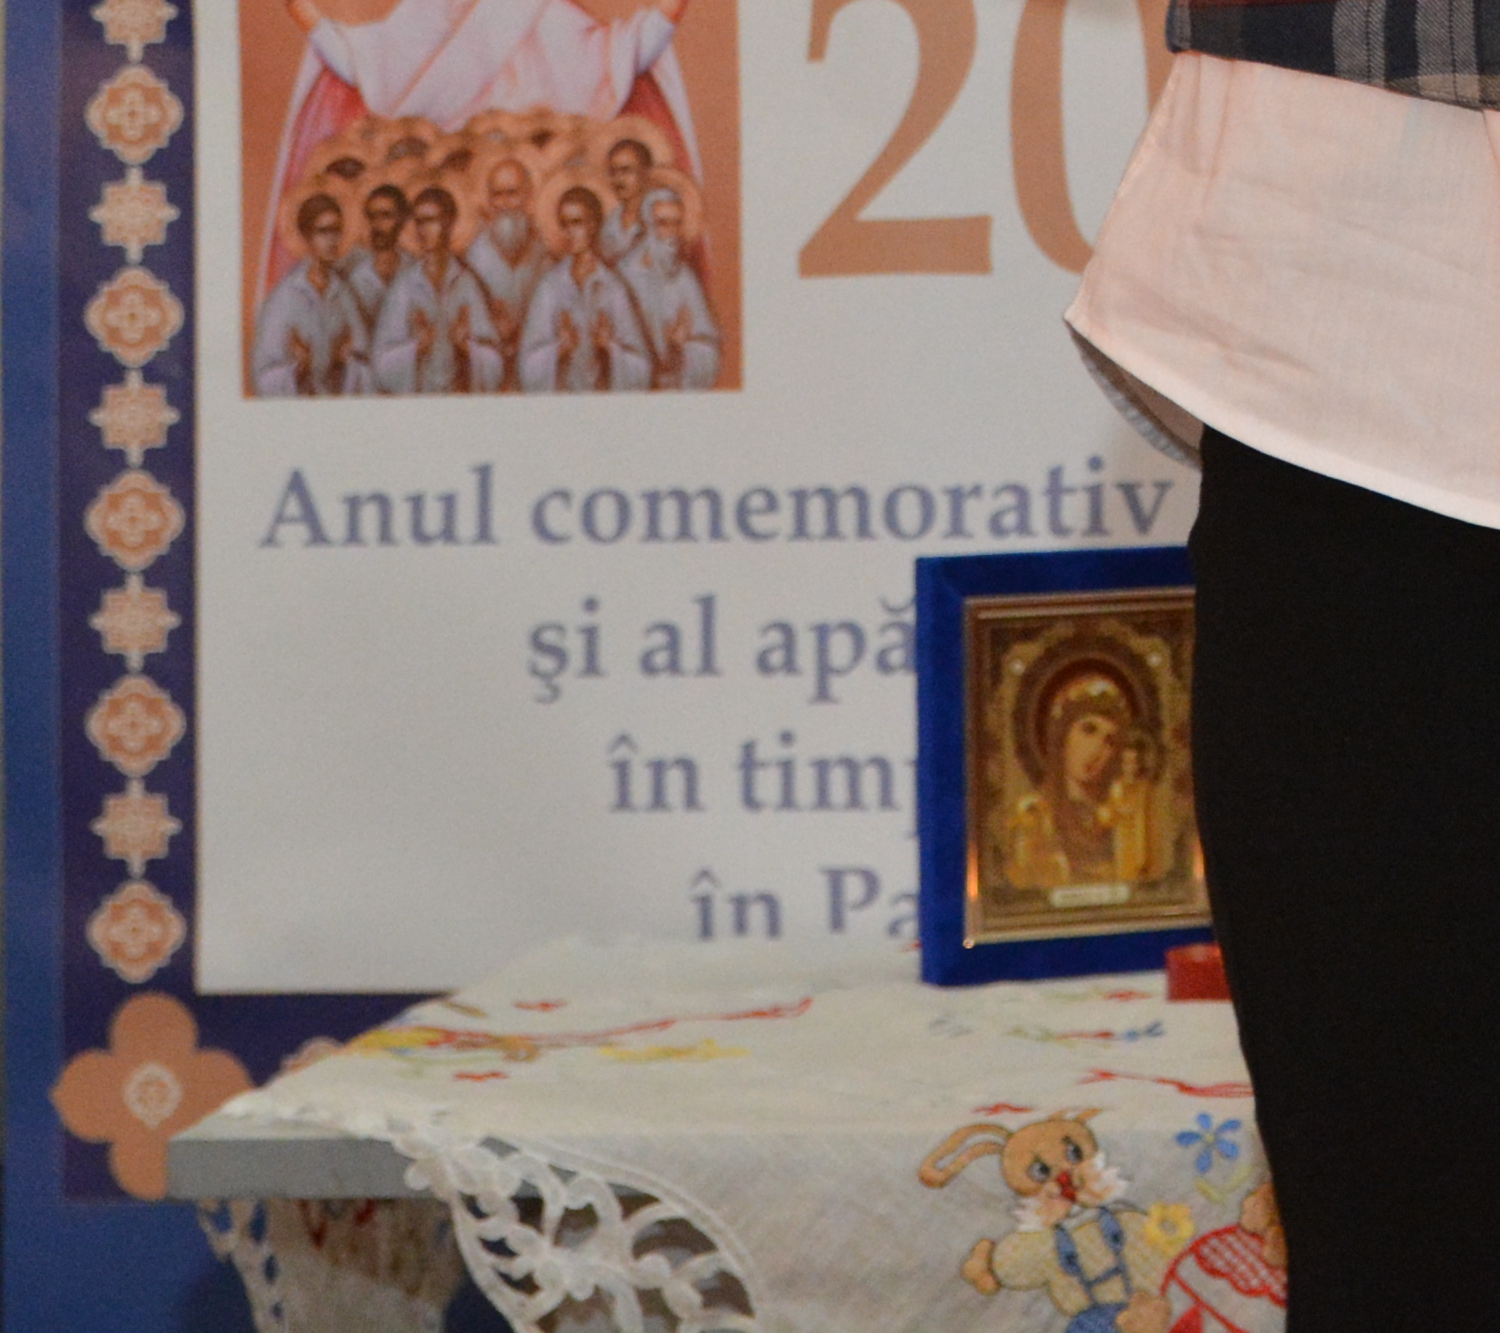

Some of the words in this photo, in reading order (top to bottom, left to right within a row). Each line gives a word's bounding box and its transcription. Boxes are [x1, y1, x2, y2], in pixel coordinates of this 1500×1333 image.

[260, 463, 501, 550] Anul
[531, 455, 1176, 546] comemorativ
[638, 594, 720, 679] al
[606, 734, 703, 814] în
[735, 729, 919, 839] tim
[690, 866, 782, 938] în
